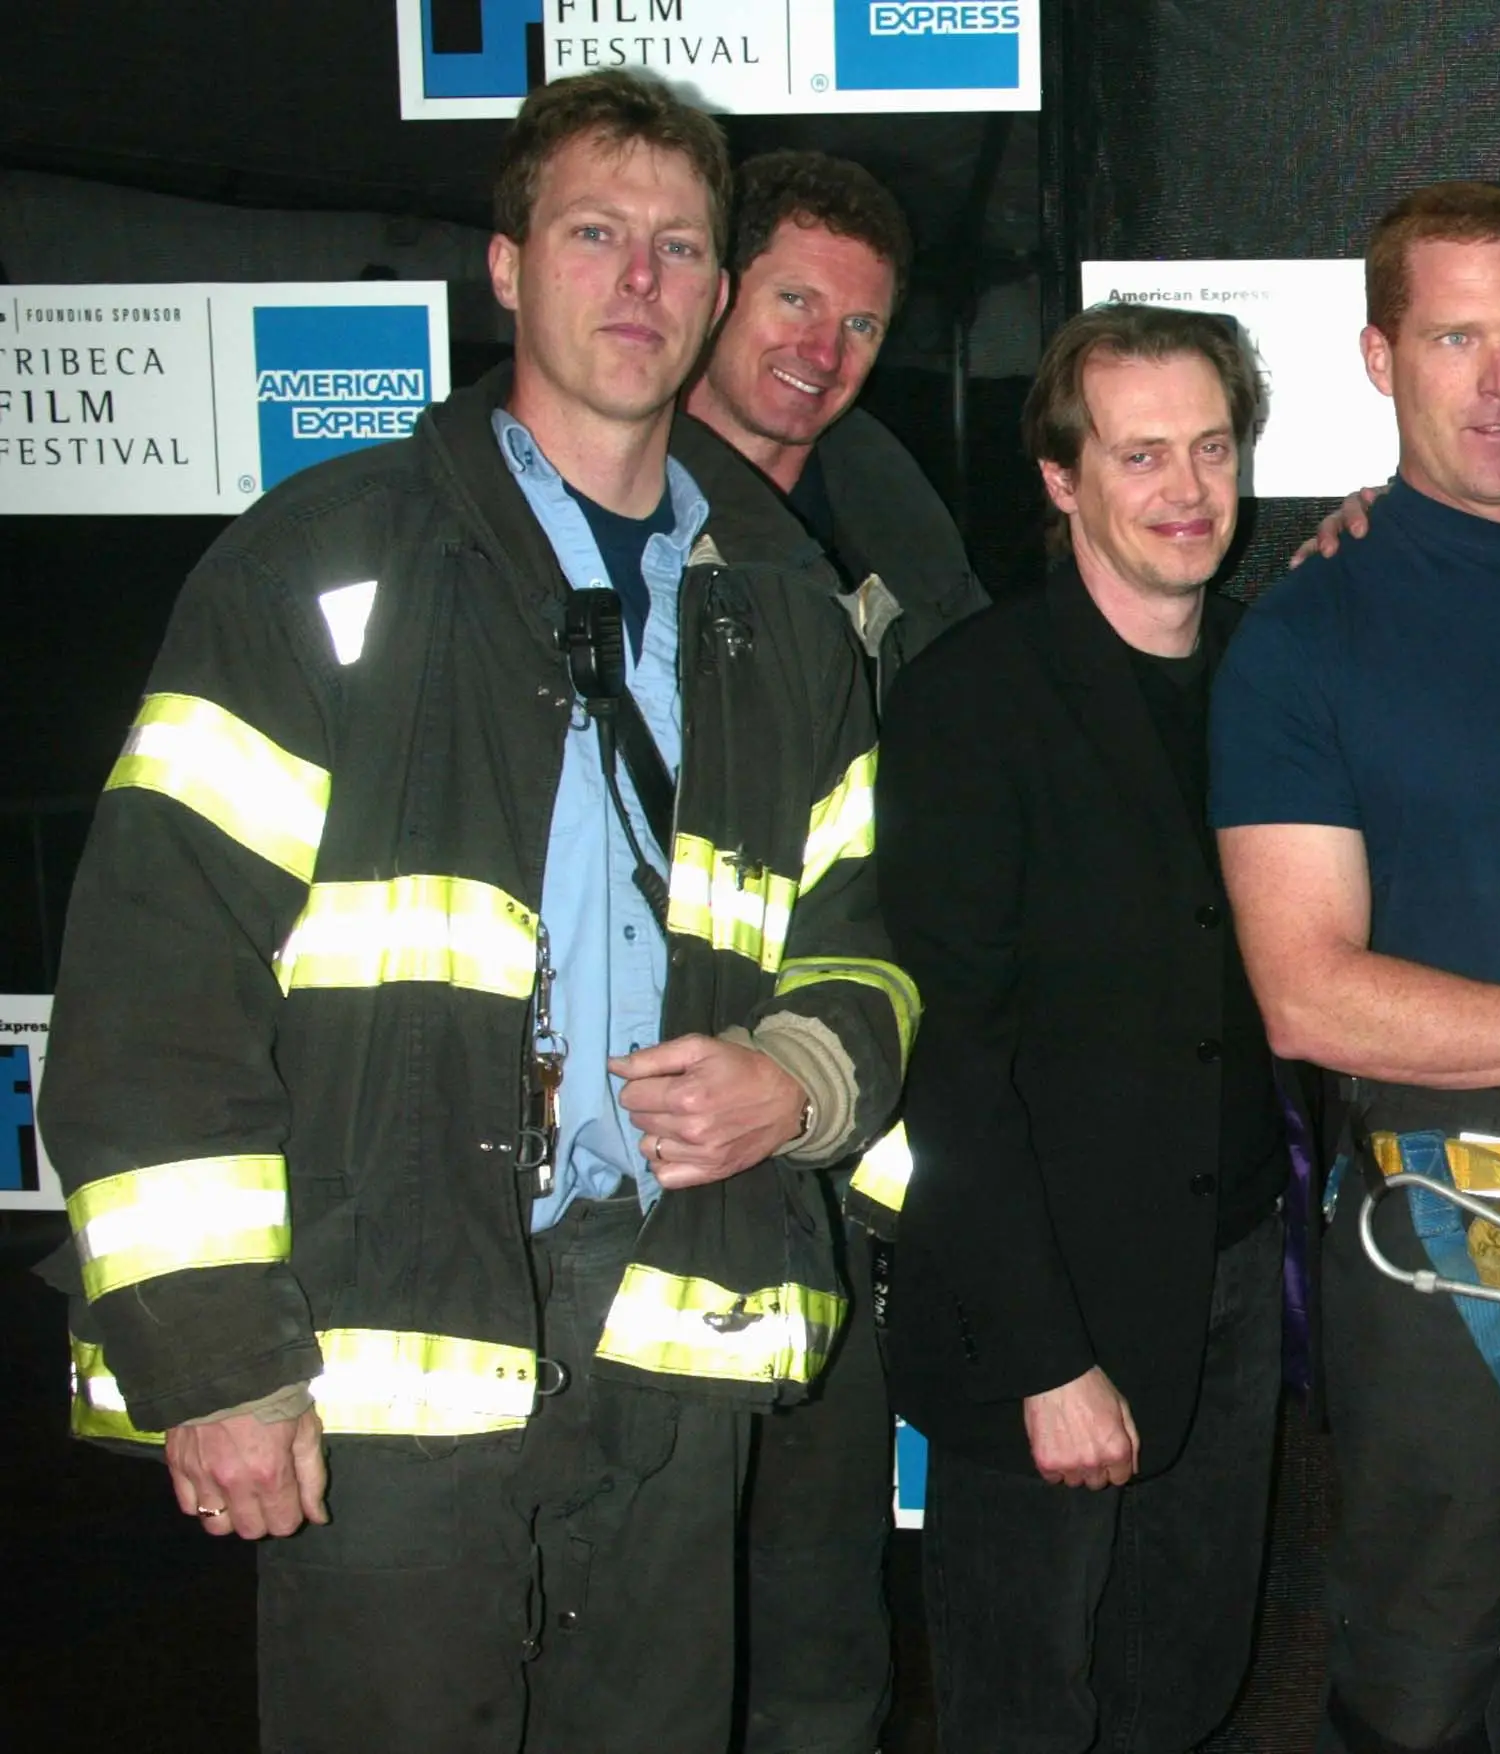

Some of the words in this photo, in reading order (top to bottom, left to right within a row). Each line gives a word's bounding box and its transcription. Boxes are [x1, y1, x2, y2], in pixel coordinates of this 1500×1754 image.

[875, 5, 1021, 31] EXPRESS
[554, 37, 760, 67] FESTIVAL
[1108, 287, 1193, 302] American
[26, 308, 103, 323] FOUNDING
[113, 307, 182, 322] SPONSOR
[0, 347, 165, 376] RIBECA
[258, 373, 420, 398] AMERICAN
[296, 411, 418, 434] EXPRES
